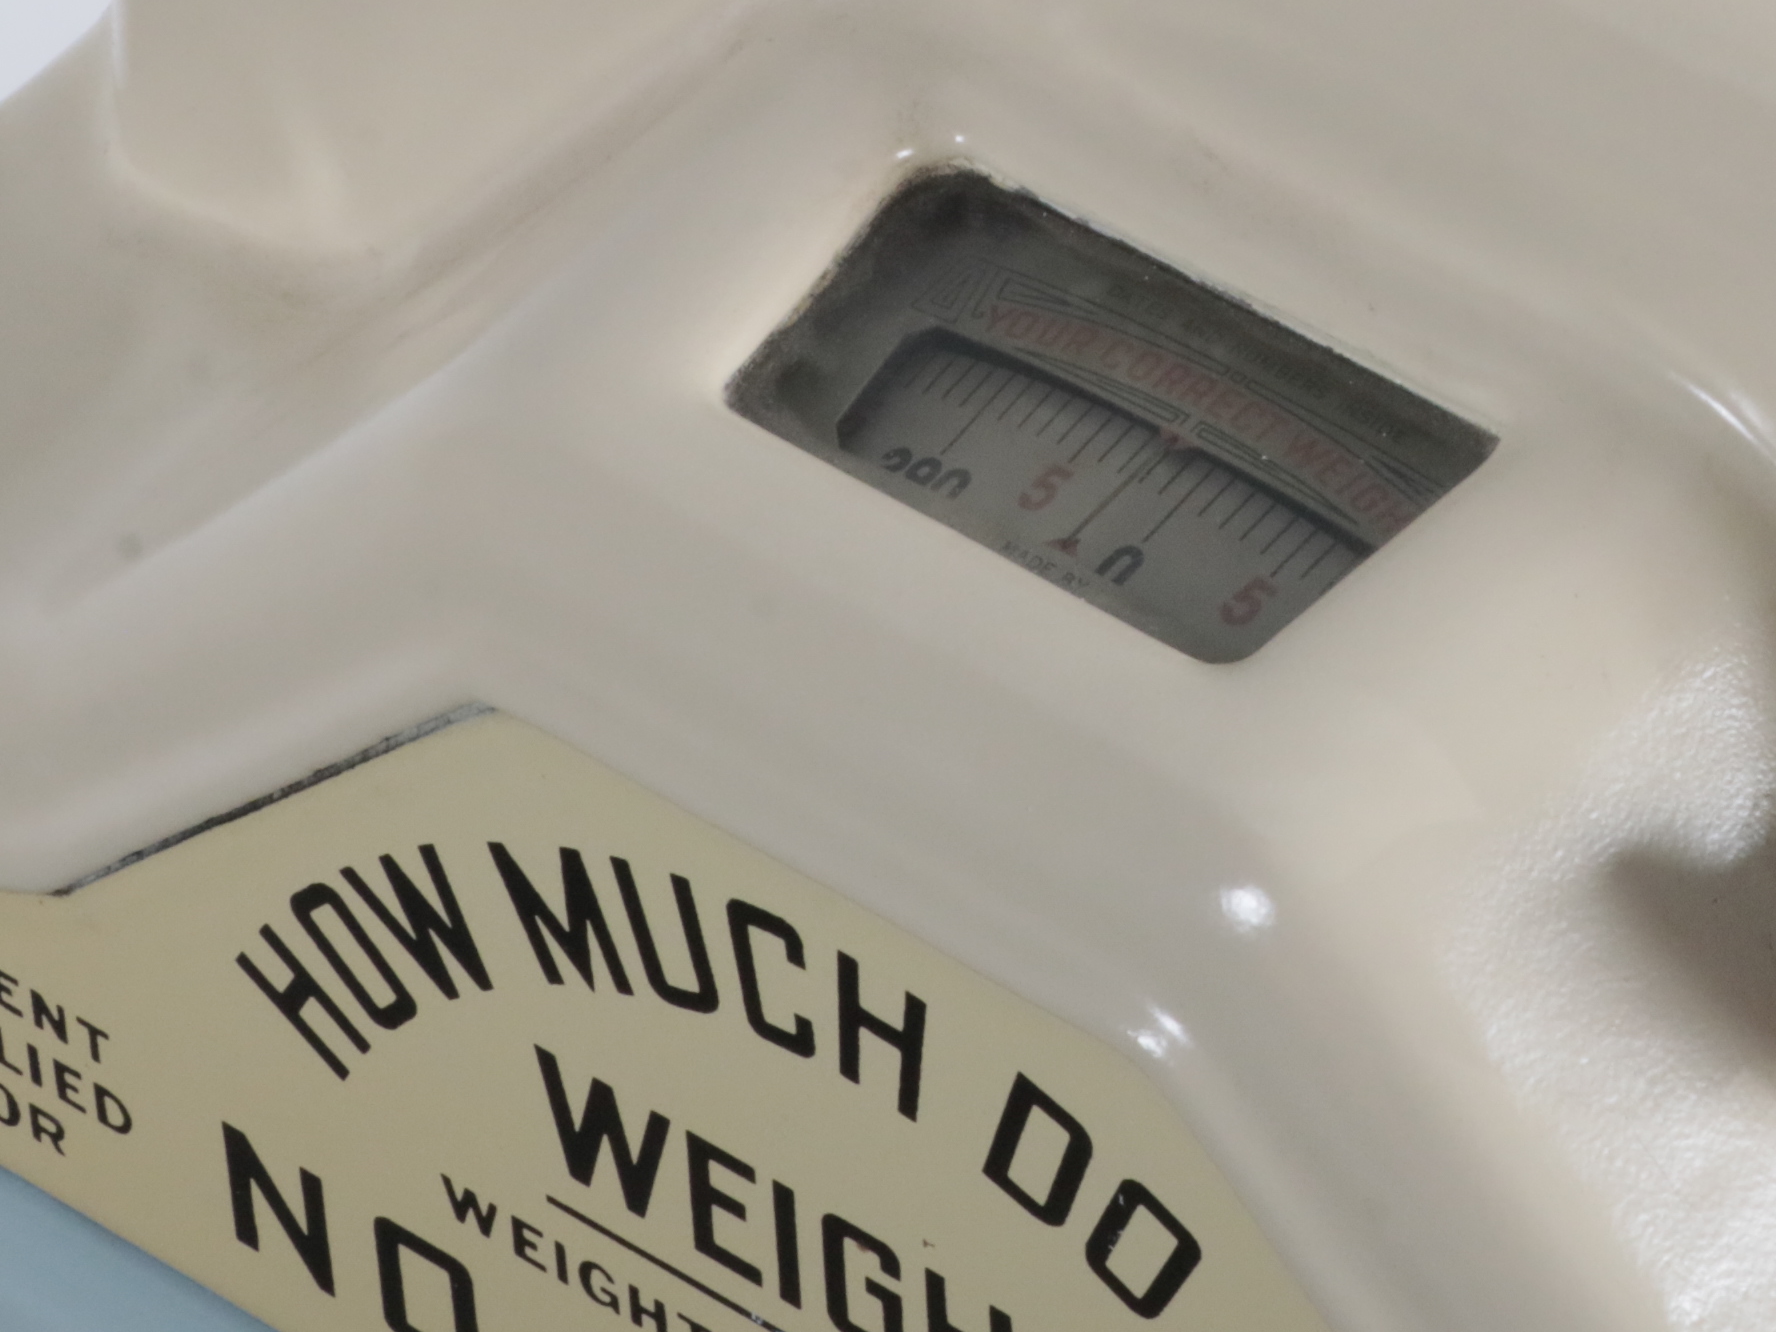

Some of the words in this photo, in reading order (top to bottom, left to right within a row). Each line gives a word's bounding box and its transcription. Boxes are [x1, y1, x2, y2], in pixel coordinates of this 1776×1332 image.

[984, 304, 1100, 358] YOUR
[1101, 336, 1290, 440] CORRECT
[1017, 462, 1075, 511] 5
[1219, 575, 1279, 626] 5
[234, 842, 494, 1081] HOW
[486, 840, 927, 1123] MUCH
[982, 1071, 1202, 1320] DO
[221, 1120, 479, 1332] NO
